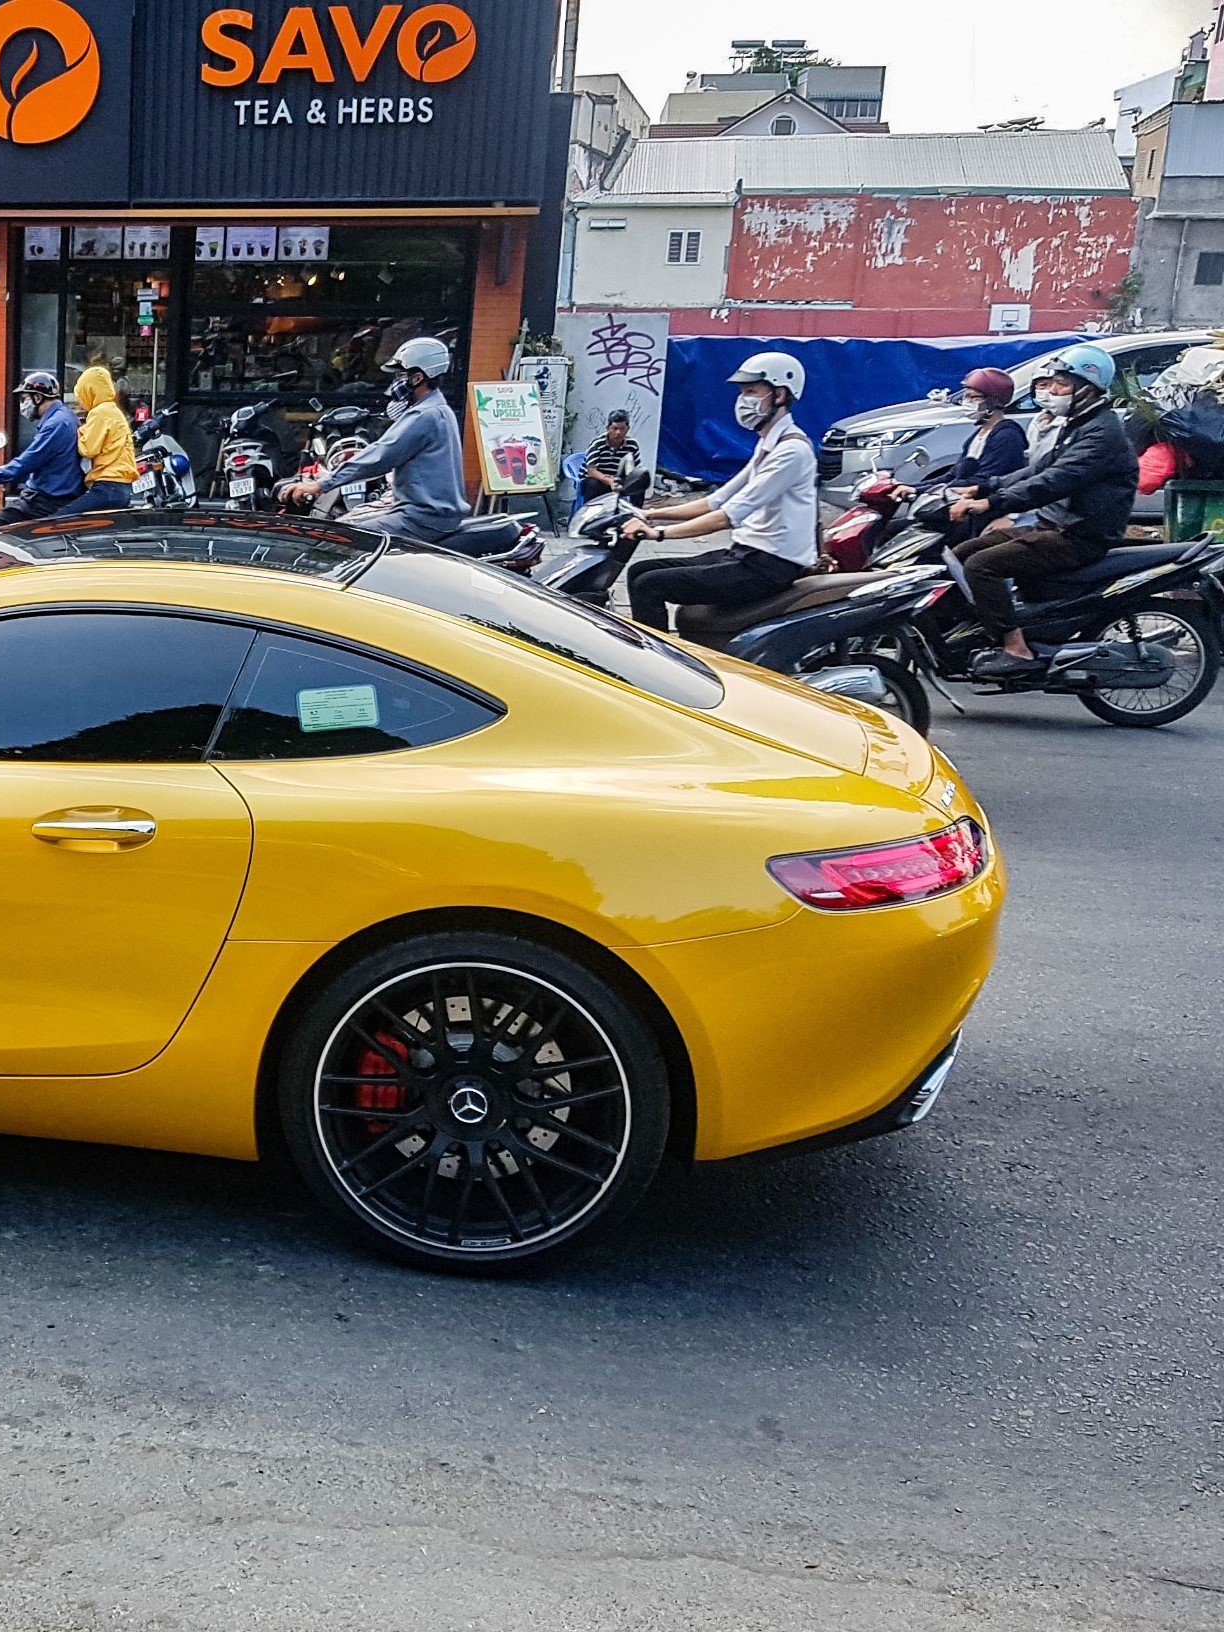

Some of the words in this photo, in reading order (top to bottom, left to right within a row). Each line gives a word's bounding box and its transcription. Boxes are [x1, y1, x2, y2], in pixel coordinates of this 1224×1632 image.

[201, 3, 476, 87] SAVO
[234, 99, 293, 126] TEA
[306, 98, 327, 125] &
[337, 97, 434, 125] HERBS
[493, 409, 522, 418] UPSIZE
[495, 400, 517, 409] FREE
